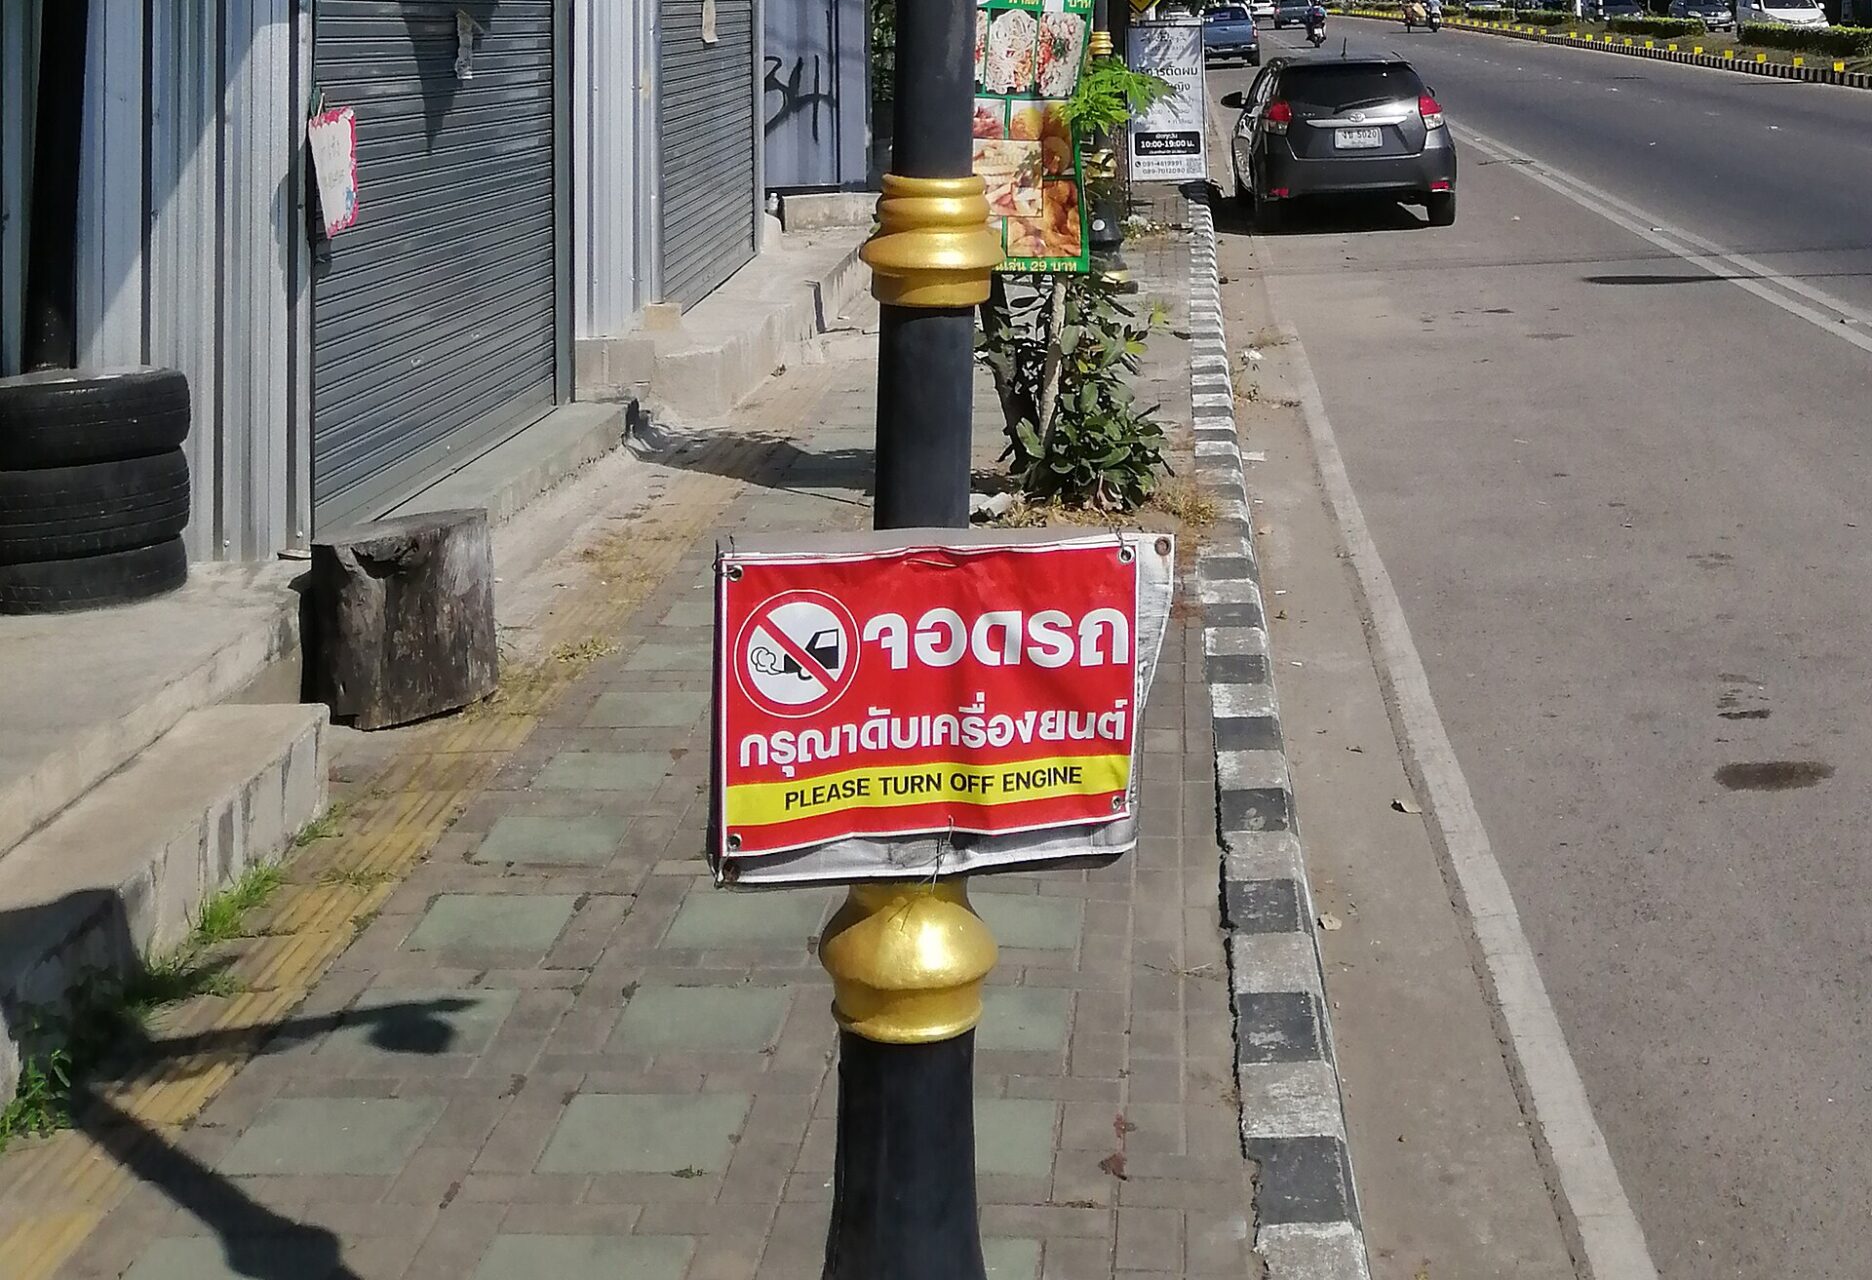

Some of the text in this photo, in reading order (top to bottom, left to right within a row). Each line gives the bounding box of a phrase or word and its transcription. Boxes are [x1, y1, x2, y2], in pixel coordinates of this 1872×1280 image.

[1140, 140, 1186, 149] 10:00-19:00
[1030, 261, 1047, 271] 29
[1050, 261, 1077, 272] บาท
[863, 607, 1130, 670] จอดรถ
[739, 691, 1128, 779] กรุณาดับเครื่องยนต์
[785, 766, 1083, 811] PLEASE TURN OFF ENGINE
